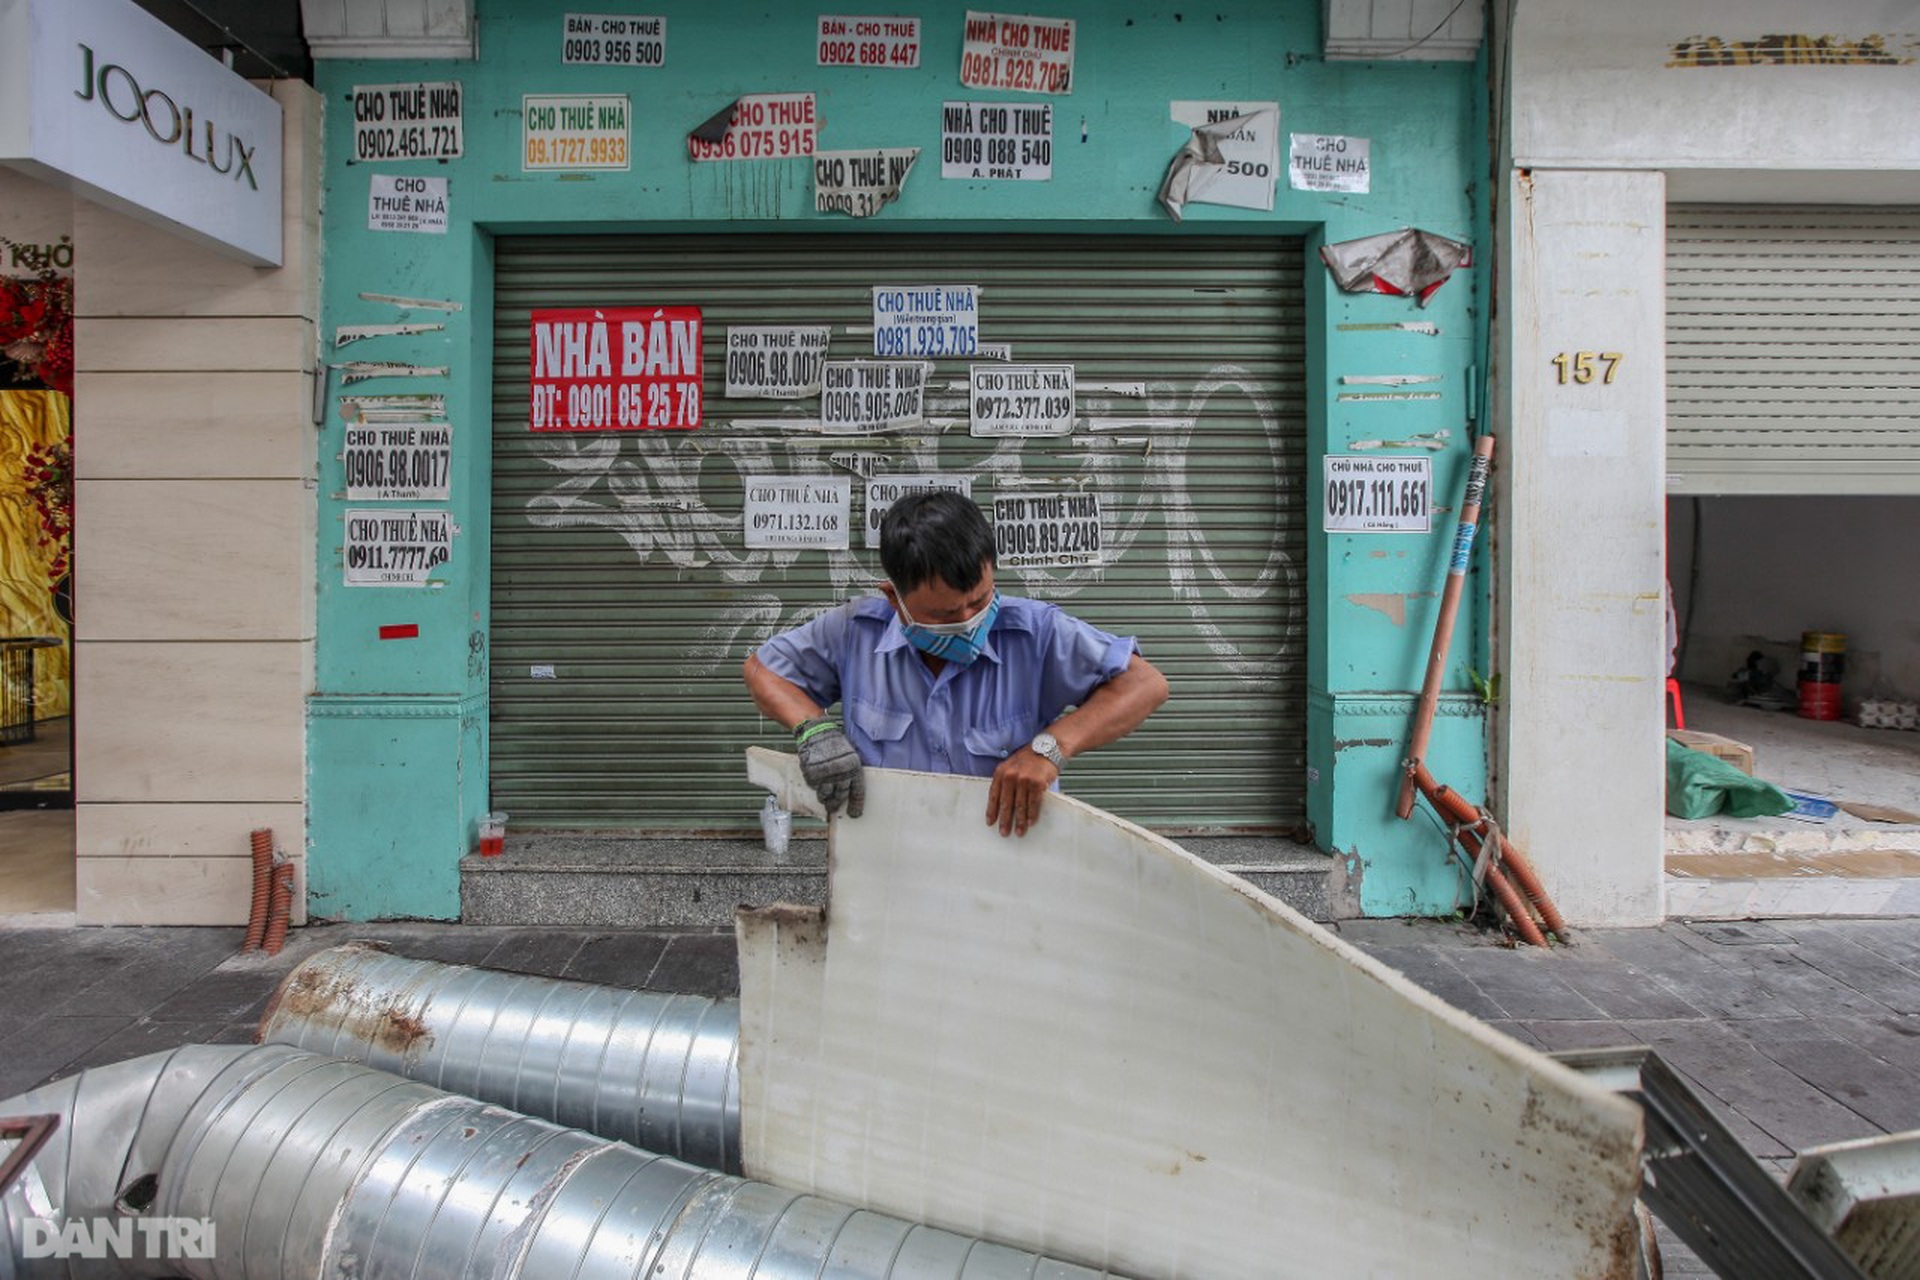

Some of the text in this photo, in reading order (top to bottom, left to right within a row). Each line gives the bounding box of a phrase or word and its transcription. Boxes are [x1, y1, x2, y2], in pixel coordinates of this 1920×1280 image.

[602, 20, 626, 34] CHO
[630, 19, 660, 36] THUÊ
[856, 22, 880, 36] CHO
[884, 21, 915, 37] THUÊ
[966, 14, 1070, 52] NHÀ CHO THUÊ
[566, 39, 662, 64] 0903 956 500
[820, 42, 918, 65] 0902 688 447
[355, 82, 459, 122] CHO THUÊ NHÀ
[529, 101, 624, 130] CHO THUÊ NHÀ
[730, 95, 814, 127] CHO THUÊ
[73, 43, 258, 191] JOOLUX
[944, 103, 1050, 136] NHÀ CHO THUÊ
[358, 125, 459, 158] 0902.461.721
[528, 138, 625, 163] 09.1727.9933
[740, 131, 774, 156] 075
[780, 128, 814, 155] 915
[944, 138, 1050, 166] 0909 088 540
[1316, 138, 1347, 152] CHO
[816, 158, 844, 187] CHO
[848, 150, 885, 187] THUÊ
[1294, 154, 1332, 172] THUÊ
[395, 178, 426, 192] CHO
[373, 195, 410, 212] THUÊ
[878, 288, 974, 312] CHO THUÊ NHÀ
[535, 309, 698, 378] NHÀ BÁN
[730, 331, 828, 347] CHO THUÊ NHÀ
[877, 326, 976, 355] 0981.929.705
[826, 367, 854, 388] CHO
[858, 364, 890, 388] THUÊ
[976, 370, 1070, 390] CHO THUÊ NHÀ
[1552, 352, 1624, 384] 157
[568, 384, 612, 428] 0901
[618, 384, 643, 427] 85
[648, 383, 671, 426] 25
[676, 382, 698, 426] 78
[826, 389, 919, 422] 0906.905.006
[976, 396, 1070, 419] 0972.377.039
[346, 427, 449, 446] CHO THUÊ NHÀ
[346, 449, 449, 488] 0906.98.0017
[1331, 459, 1351, 472] CHỦ
[1353, 460, 1374, 472] NHÀ
[1376, 462, 1396, 472] CHO
[750, 484, 838, 504] CHO THUÊ NHÀ
[870, 484, 898, 501] CHO
[1328, 480, 1426, 516] 0917.111.661
[996, 493, 1098, 520] CHO THUÊ NHÀ
[350, 512, 448, 542] CHO THUÊ NHÀ
[754, 513, 838, 530] 0971.132.168
[997, 522, 1099, 555] 0909.89.2248
